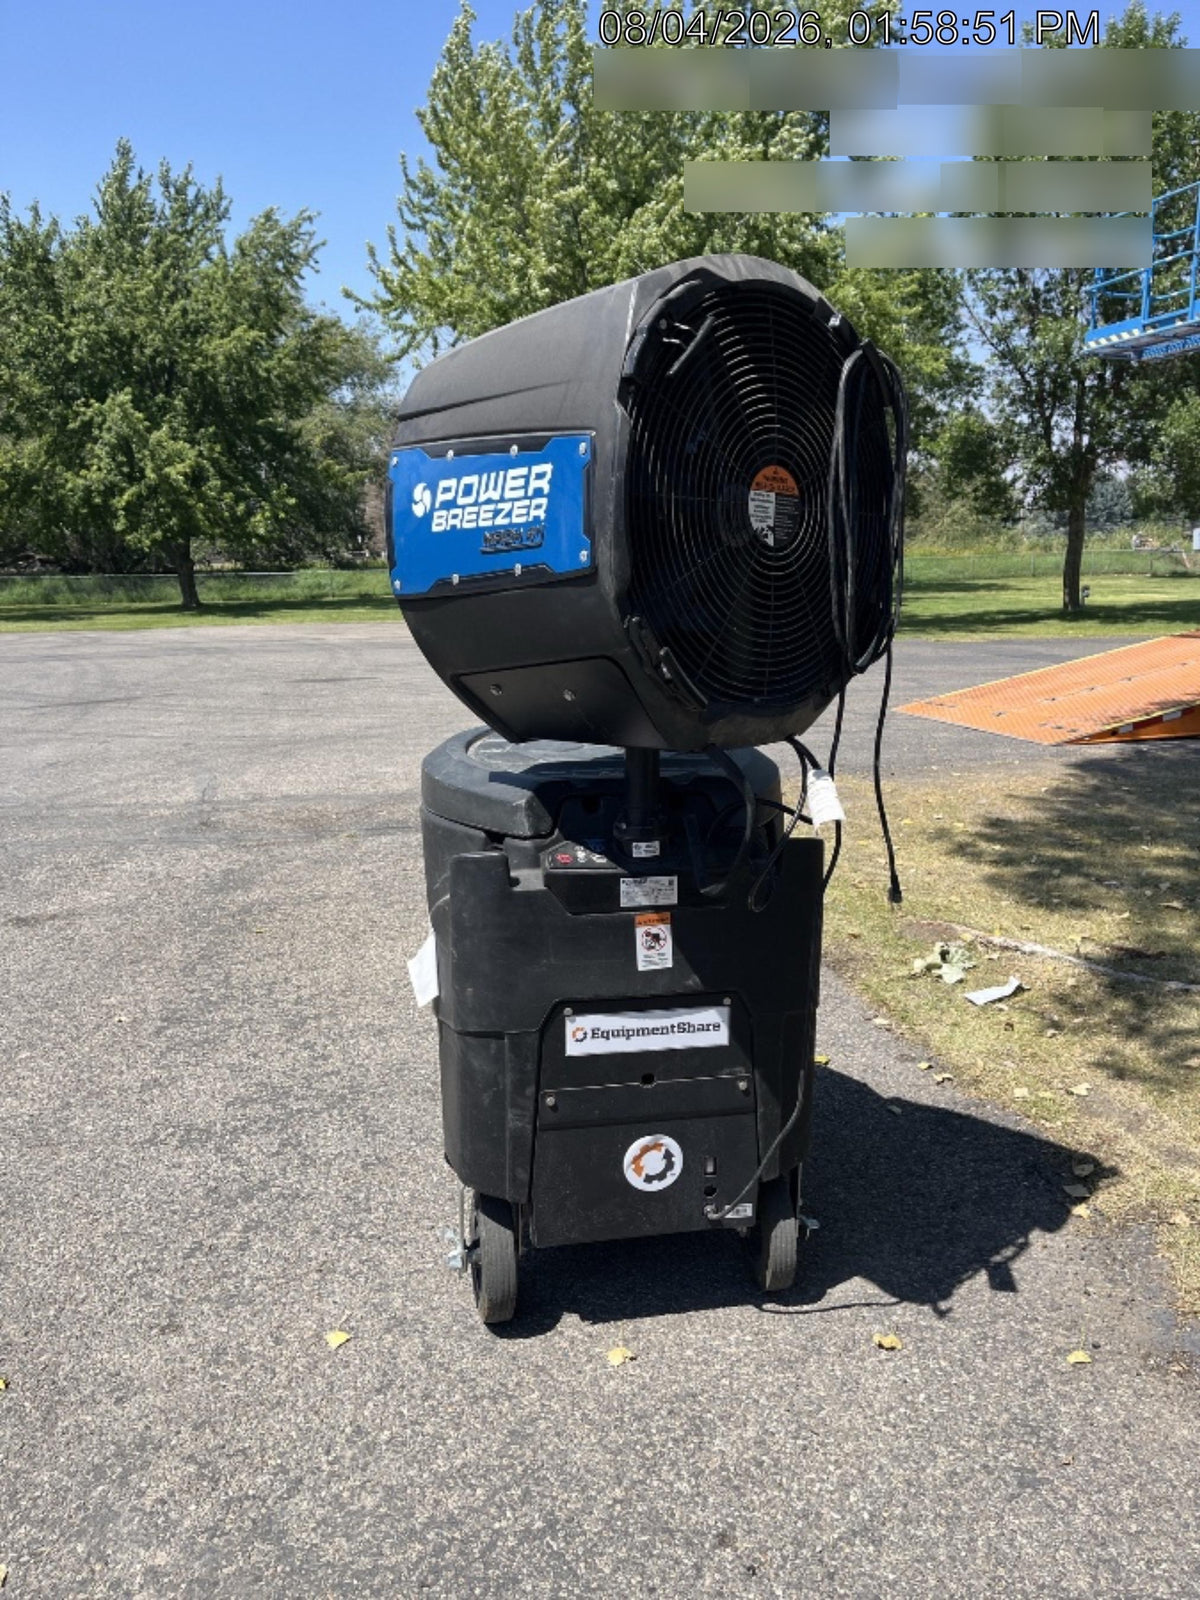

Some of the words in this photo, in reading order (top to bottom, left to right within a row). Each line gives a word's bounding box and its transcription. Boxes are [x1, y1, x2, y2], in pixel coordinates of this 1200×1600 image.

[435, 463, 553, 508] POWER
[431, 497, 548, 533] BREEZER
[590, 1021, 721, 1041] EquipmentShare
